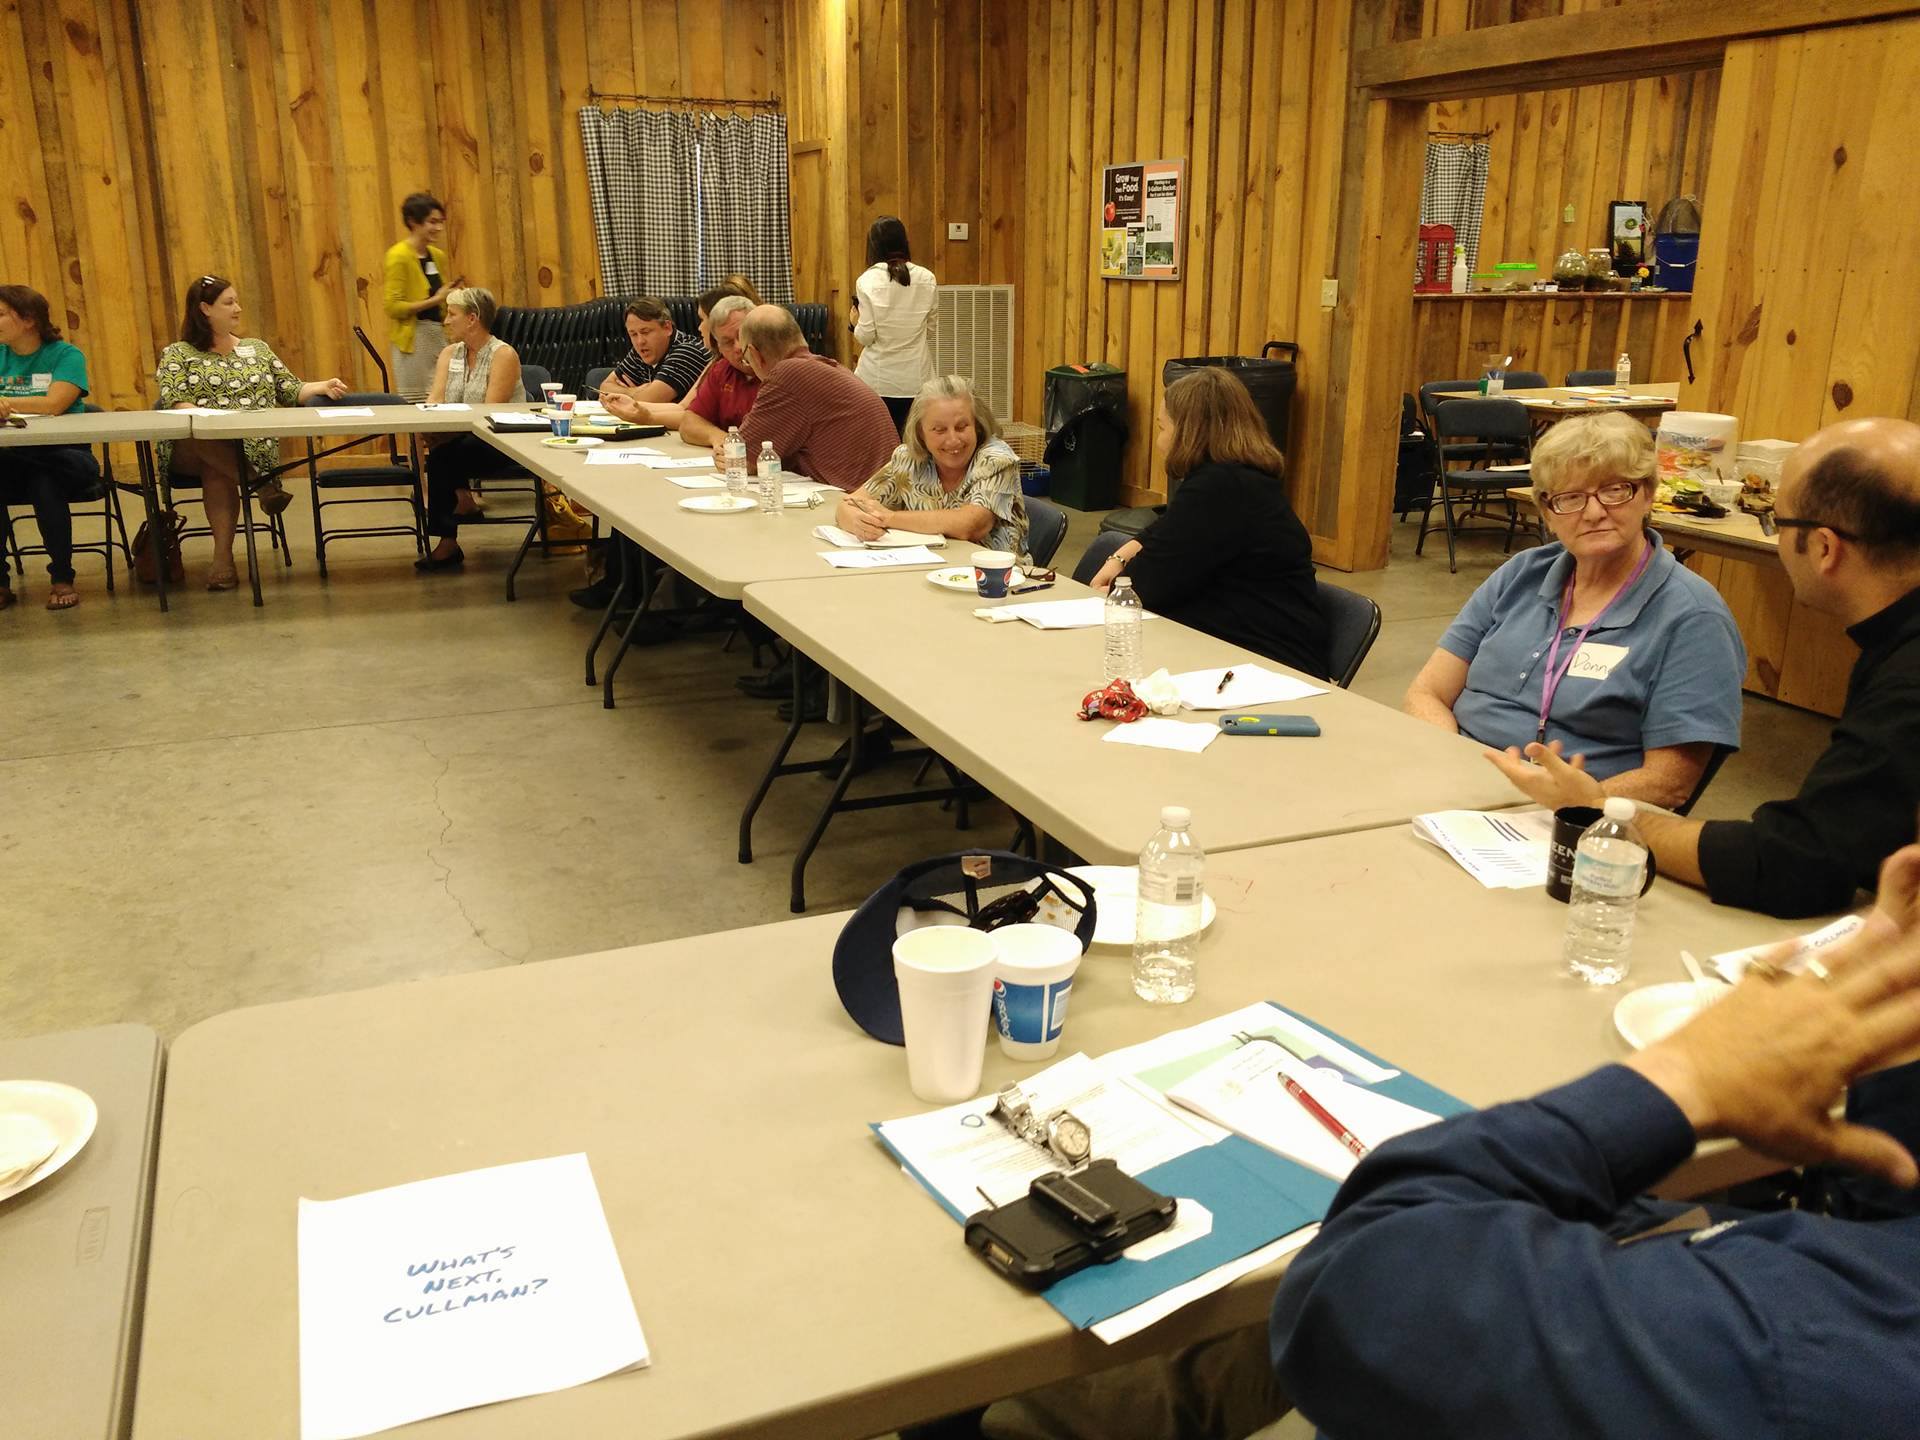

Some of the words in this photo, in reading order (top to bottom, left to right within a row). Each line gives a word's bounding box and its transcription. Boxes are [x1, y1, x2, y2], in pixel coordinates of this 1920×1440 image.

[1115, 174, 1130, 183] Grow
[406, 1246, 517, 1277] WHAT'S
[383, 1278, 549, 1323] CULLMAN?
